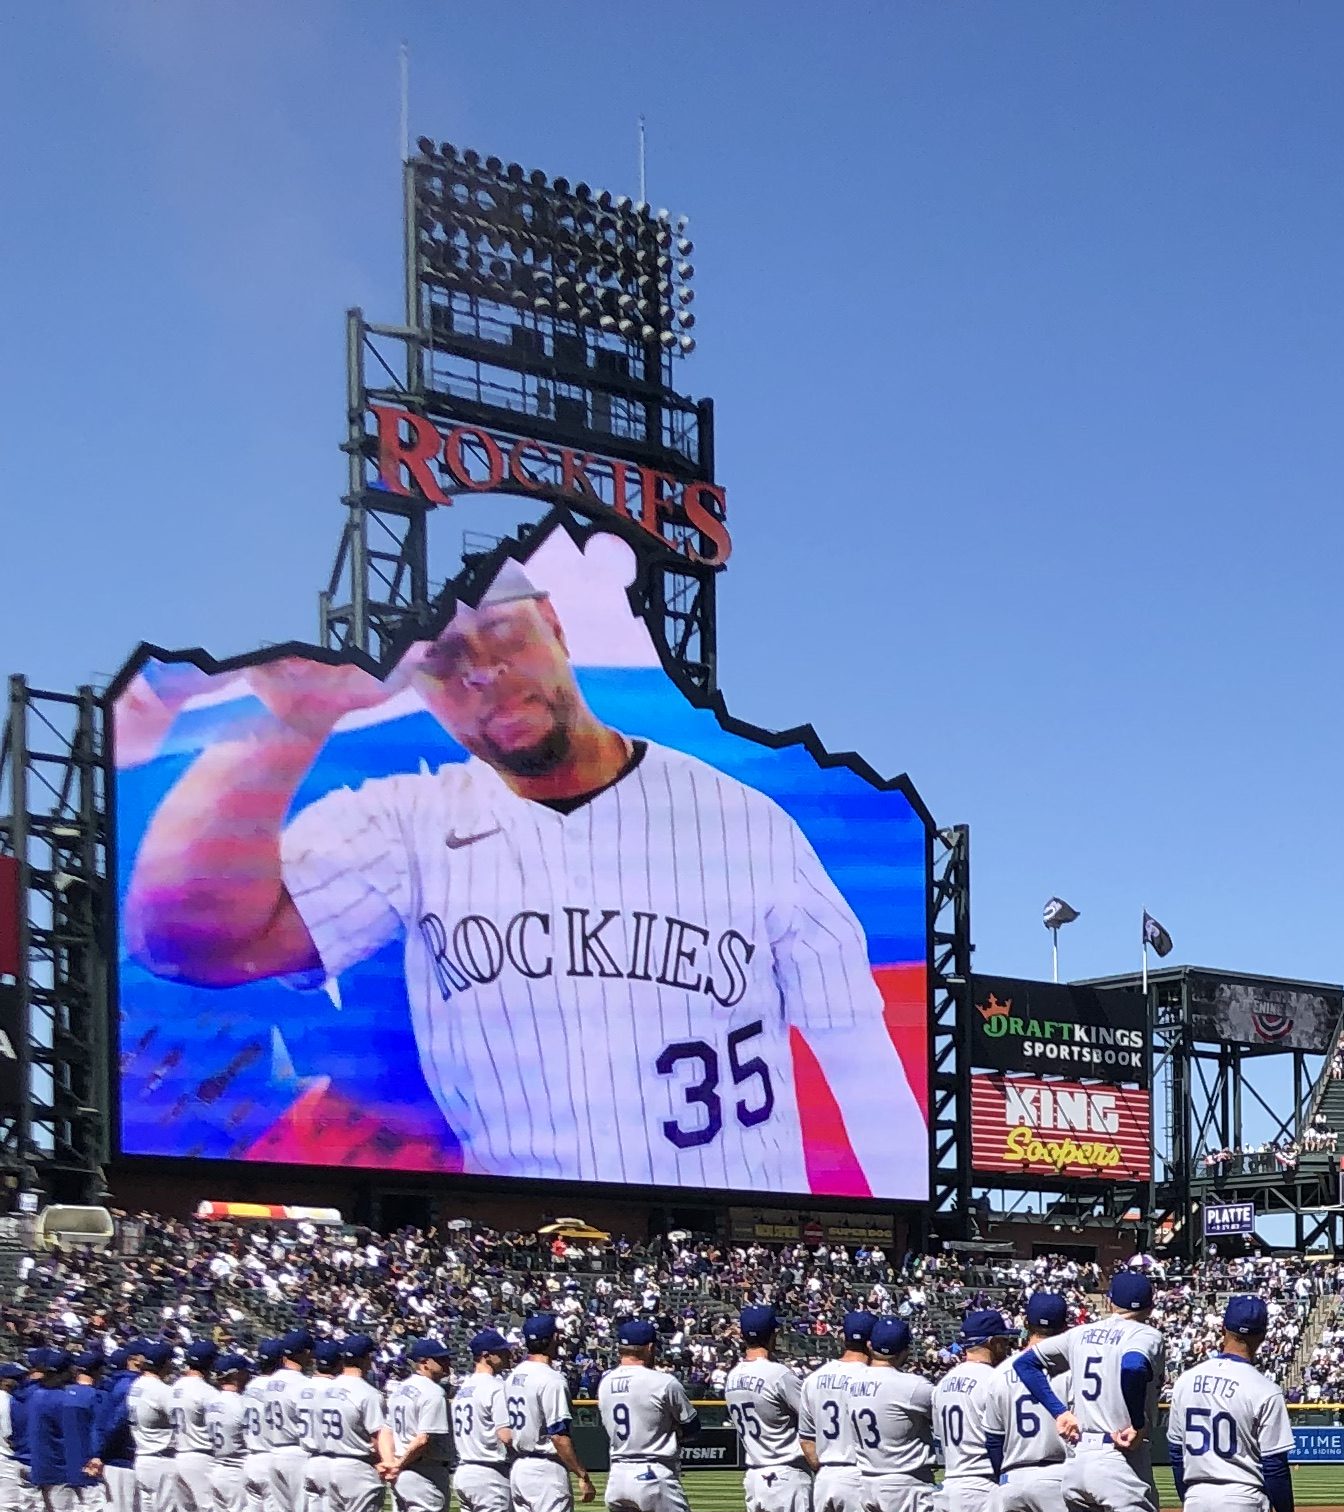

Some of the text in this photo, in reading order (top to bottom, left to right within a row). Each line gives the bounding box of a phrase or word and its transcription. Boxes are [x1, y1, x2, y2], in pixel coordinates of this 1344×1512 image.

[366, 402, 733, 566] ROCKIES
[418, 906, 756, 1008] ROCKIES
[982, 1014, 1143, 1049] DRAFTKINGS
[1022, 1040, 1142, 1068] SPORTSBOOK
[655, 1020, 775, 1149] 35
[1004, 1085, 1121, 1134] KING
[1002, 1126, 1122, 1172] Soopers
[1207, 1206, 1251, 1224] PLATTE
[1081, 1355, 1104, 1402] 5
[1192, 1374, 1240, 1399] BETTS
[454, 1403, 474, 1437] 63
[507, 1395, 526, 1431] 66
[612, 1402, 631, 1442] 9
[730, 1401, 762, 1440] 35
[822, 1400, 840, 1440] 3
[851, 1407, 882, 1450] 13
[941, 1404, 964, 1447] 10
[1015, 1393, 1041, 1439] 6
[1185, 1406, 1239, 1459] 50
[1312, 1448, 1342, 1456] SIDING
